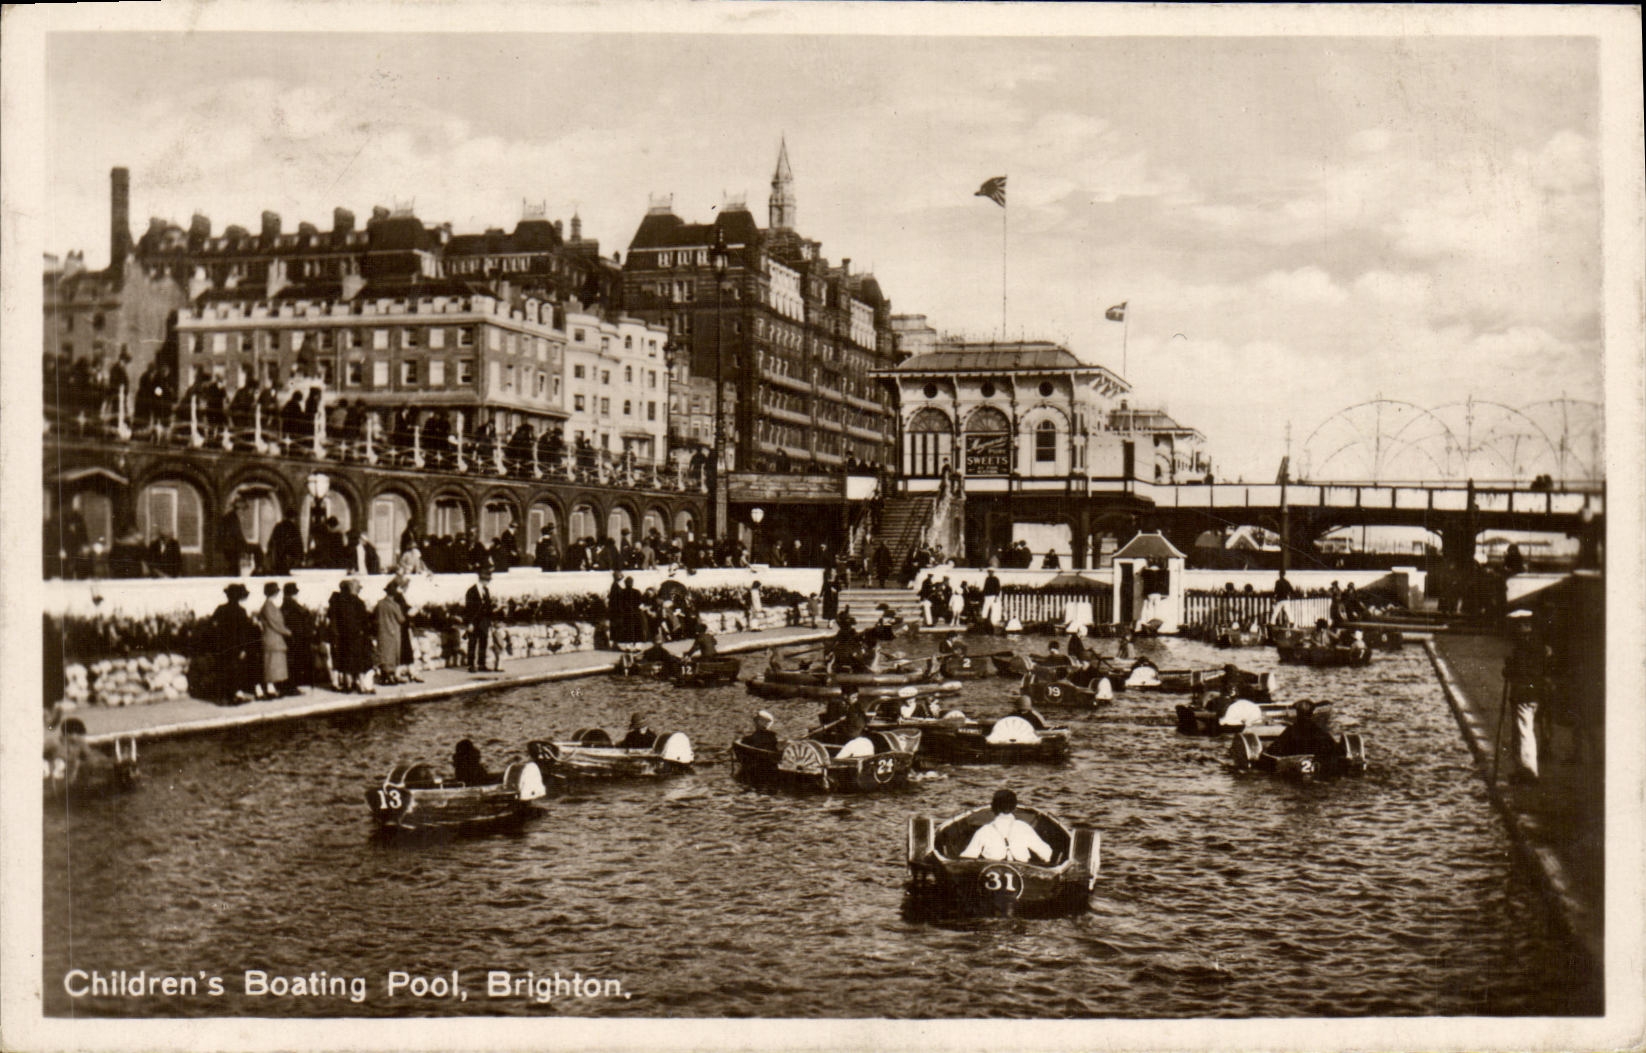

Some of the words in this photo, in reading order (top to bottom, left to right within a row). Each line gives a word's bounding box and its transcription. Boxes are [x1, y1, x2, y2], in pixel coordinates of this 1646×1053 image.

[967, 456, 1009, 466] SWEETS
[681, 665, 693, 675] 12
[1047, 686, 1061, 697] 19
[877, 758, 894, 775] 24
[377, 789, 402, 809] 13
[984, 871, 1016, 892] 31
